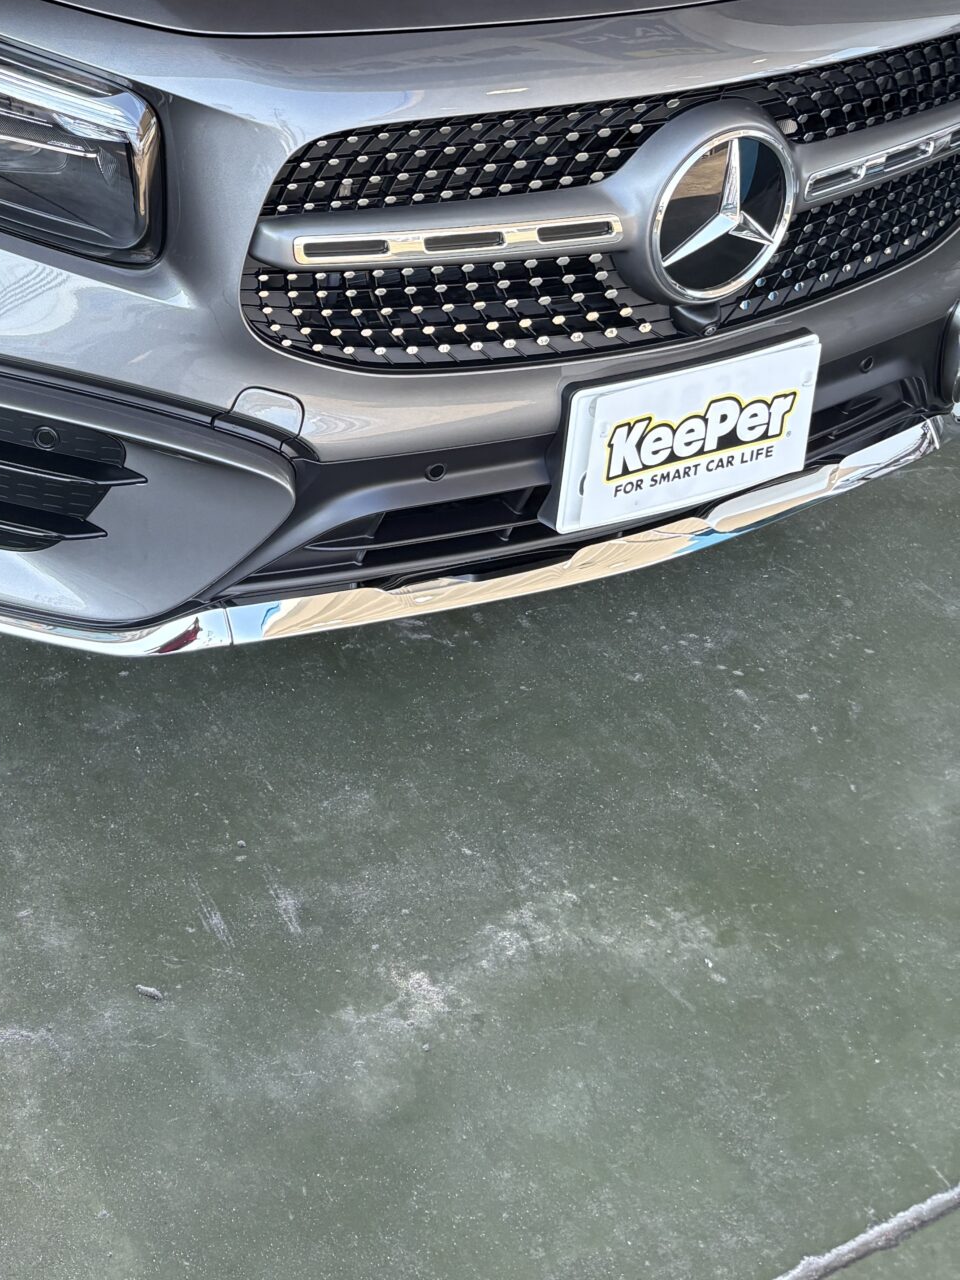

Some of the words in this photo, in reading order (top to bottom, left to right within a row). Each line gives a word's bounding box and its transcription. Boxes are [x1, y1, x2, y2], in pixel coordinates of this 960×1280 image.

[606, 391, 797, 481] KeePer
[613, 478, 644, 498] FOR
[650, 464, 702, 488] SMART
[706, 456, 735, 473] CAR
[740, 446, 774, 465] LIFE
